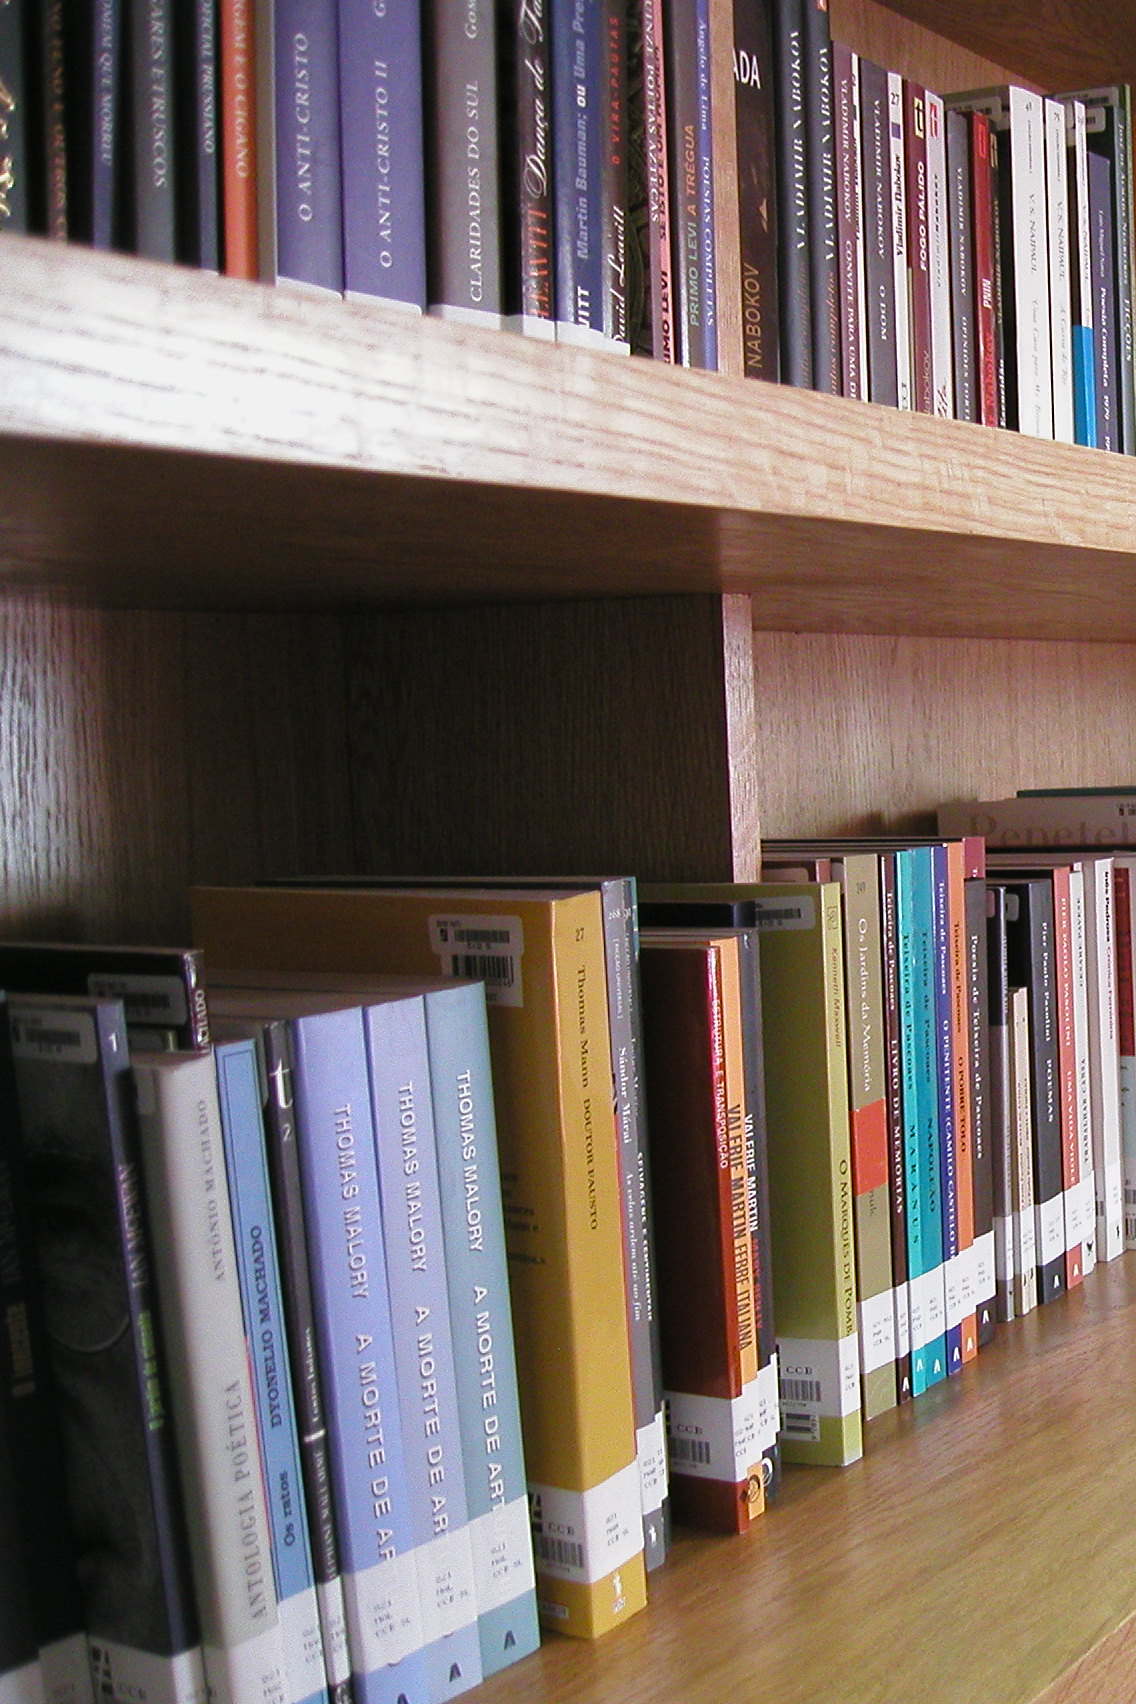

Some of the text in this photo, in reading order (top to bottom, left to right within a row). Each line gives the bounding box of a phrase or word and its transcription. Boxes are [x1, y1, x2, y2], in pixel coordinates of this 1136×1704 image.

[202, 63, 215, 154] PRUSSIANO
[524, 58, 545, 91] de
[608, 16, 621, 143] VIRA-PAUTAS
[841, 79, 850, 149] VLADIMIR
[102, 93, 113, 165] MORREU
[151, 67, 167, 188] ETRUSCOS
[235, 73, 248, 178] O CIGANO
[294, 32, 313, 221] O ANTI-CRISTO
[375, 60, 393, 268] O ANTI-CRISTO II
[524, 99, 550, 199] Dança
[574, 40, 590, 259] Martin Bauman; ou Uma
[611, 155, 621, 164] O
[646, 64, 660, 223] POETAS AZTECAS
[790, 31, 806, 250] VLADIMIR NABOKOV
[819, 48, 835, 261] VLADIMIR NABOKOV
[874, 99, 882, 177] VLADIMIR
[466, 80, 483, 301] CLARIDADES DO SUL
[683, 124, 701, 326] PRIMO LEVI A TRÉGUA
[843, 153, 851, 222] NABOKOV
[876, 182, 884, 260] NABOKOV
[895, 206, 904, 257] Vladimir
[917, 162, 926, 271] FOGO PÁLIDO
[957, 167, 965, 229] VLADIMIR
[607, 204, 626, 286] Leavitt
[702, 155, 715, 326] POESIAS COMPLETAS
[1029, 220, 1037, 276] NAIPAUL
[1057, 227, 1067, 282] NAIPAUL
[661, 270, 669, 314] LEVI
[743, 262, 763, 368] NABOKOV
[847, 307, 855, 342] PARA
[1123, 298, 1132, 362] FICÇÕES
[848, 345, 856, 378] UMA
[982, 278, 995, 408] Nabokov PNIN
[573, 928, 585, 942] 27
[888, 939, 894, 956] de
[940, 928, 946, 943] de
[108, 1033, 119, 1055] 1
[858, 917, 872, 1092] Os Jardins da Memória
[905, 1000, 911, 1018] de
[970, 934, 984, 1160] Poesia de Teixeira de Pascoaes
[577, 965, 597, 1231] Thomas Mann DOUTOR FAUSTO
[619, 1046, 632, 1145] Sándor Márai
[716, 1069, 723, 1078] E
[891, 1039, 899, 1090] LIVRO
[906, 1023, 914, 1090] Pascoaes
[1046, 1059, 1054, 1123] POEMAS
[196, 1099, 216, 1192] MACHADO
[716, 1080, 728, 1170] TRANSPOSIÇÃO
[893, 1096, 899, 1120] DE
[745, 1113, 759, 1232] VALERIE MARTIN
[893, 1125, 903, 1214] MEMÓRIAS
[927, 1117, 936, 1213] NAPOLEÃO
[455, 1069, 501, 1455] THOMAS MALORY A MORTE DE
[727, 1102, 752, 1351] VALERIE MARTIN ITALIANA
[839, 1158, 847, 1177] O
[844, 1262, 851, 1284] DE
[250, 1225, 283, 1429] DYONELIO MACHADO
[334, 1103, 392, 1519] THOMAS MALORY A MORTE DE
[398, 1080, 449, 1536] THOMAS MALORY A MORTE DE AR
[785, 1364, 814, 1376] CCB
[676, 1423, 704, 1436] CCB
[223, 1380, 268, 1621] ANTOLOGIA POÉTICA
[279, 1470, 296, 1547] Os ratos
[548, 1520, 575, 1537] CCB
[448, 1662, 463, 1683] A
[503, 1630, 517, 1651] A
